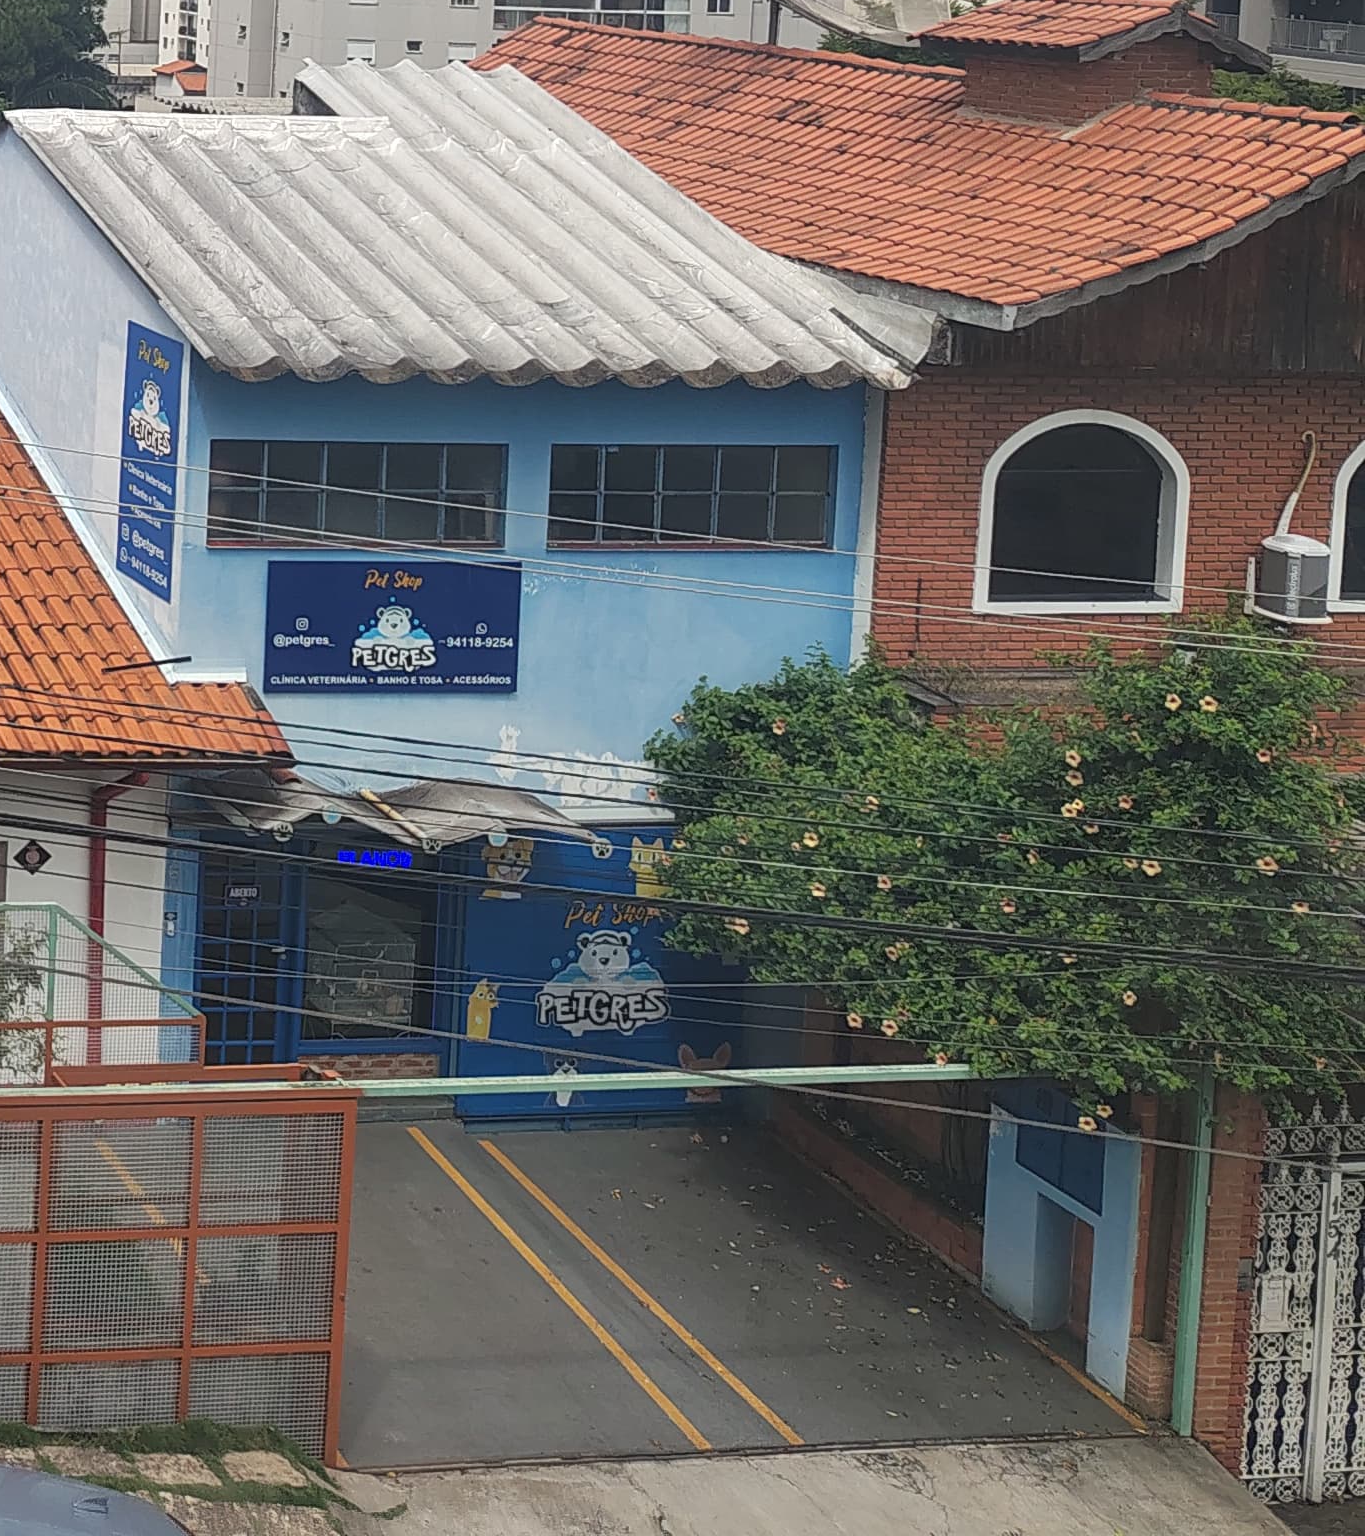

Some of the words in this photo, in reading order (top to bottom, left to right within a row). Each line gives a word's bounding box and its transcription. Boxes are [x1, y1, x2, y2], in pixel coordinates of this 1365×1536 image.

[129, 415, 171, 452] PETGRES
[364, 569, 388, 589] Pet
[394, 570, 423, 591] Shop
[273, 634, 335, 648] @petgres_
[352, 645, 437, 671] PETGRES
[270, 673, 306, 685] CLÍNICA
[308, 674, 367, 685] VETERINÁRIA
[377, 675, 410, 685] BANHO
[411, 676, 417, 685] E
[419, 675, 443, 685] TOSA
[453, 673, 512, 685] ACESSÓRIOS
[564, 899, 604, 929] Pet
[537, 989, 669, 1032] PETGRES
